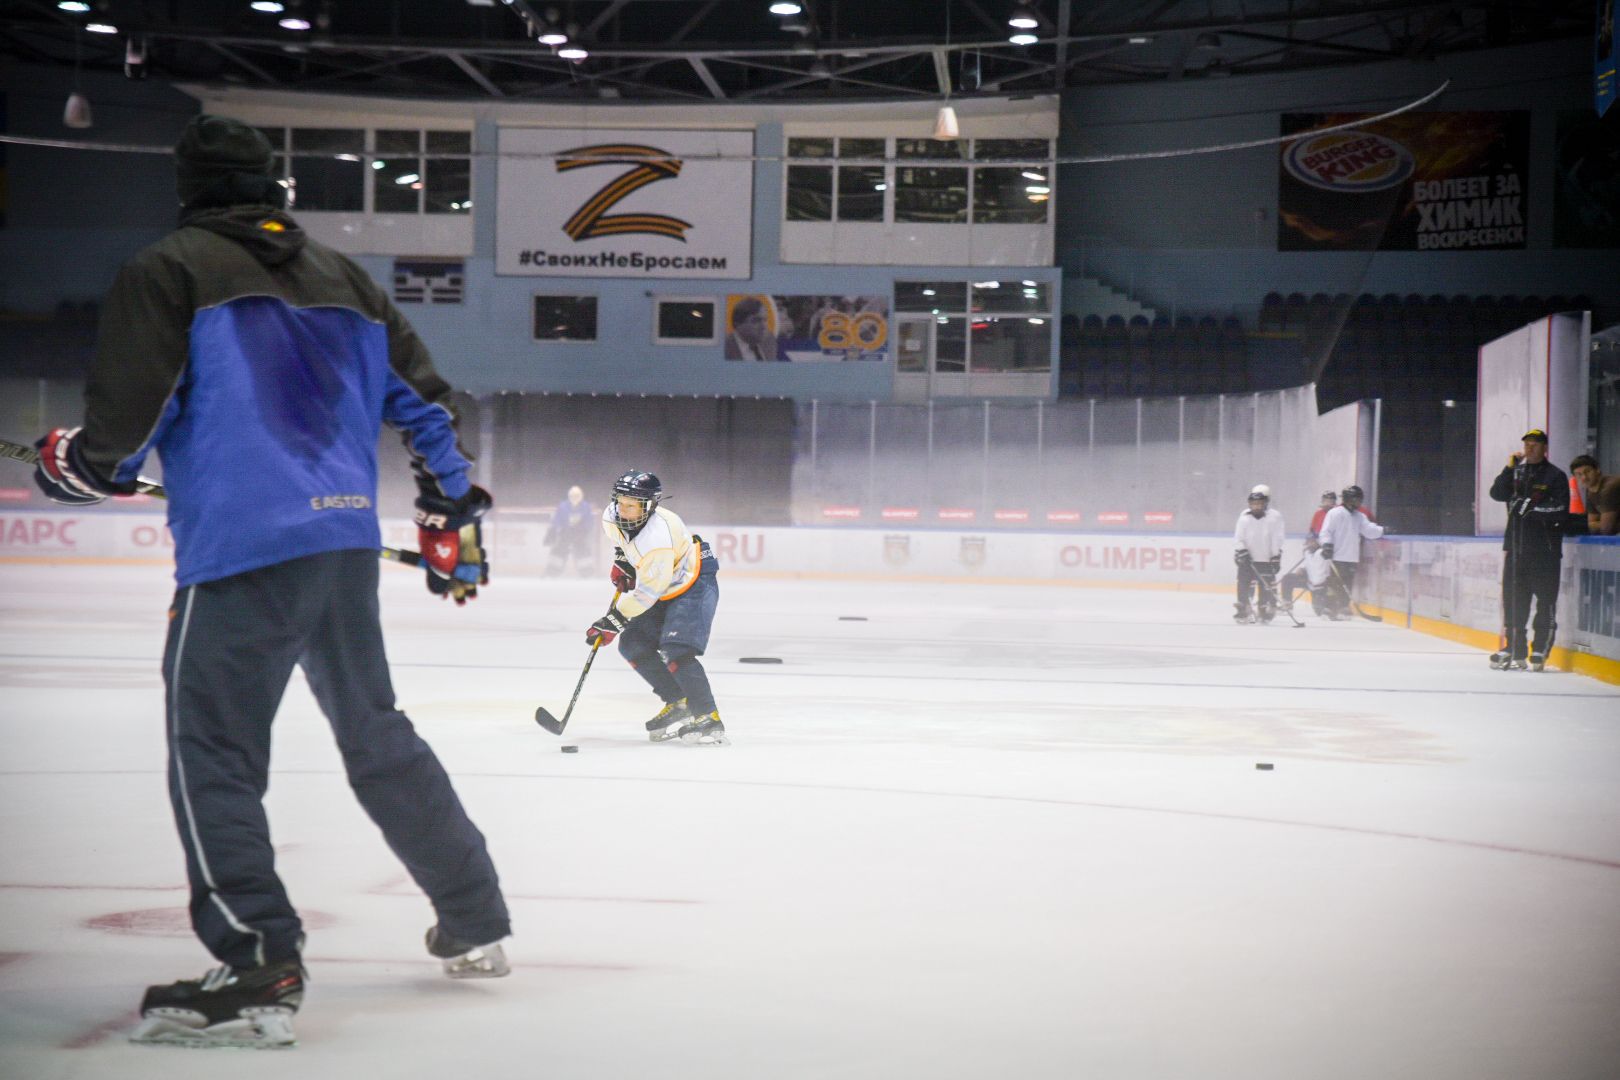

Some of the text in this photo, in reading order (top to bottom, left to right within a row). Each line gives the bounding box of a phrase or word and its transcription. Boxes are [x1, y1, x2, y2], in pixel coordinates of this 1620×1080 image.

[1302, 136, 1382, 170] BURGER
[1317, 144, 1396, 183] KING
[1413, 173, 1521, 202] БОЛЕЕТ ЗА
[1416, 196, 1523, 233] ХИМИК
[1417, 226, 1525, 250] ВОСКРЕСЕНСК
[519, 250, 727, 271] #СвоихНеБросаем
[818, 312, 888, 352] 80
[310, 495, 371, 511] EASTON
[0, 519, 79, 545] АРС
[1059, 545, 1211, 572] OLIMPBET
